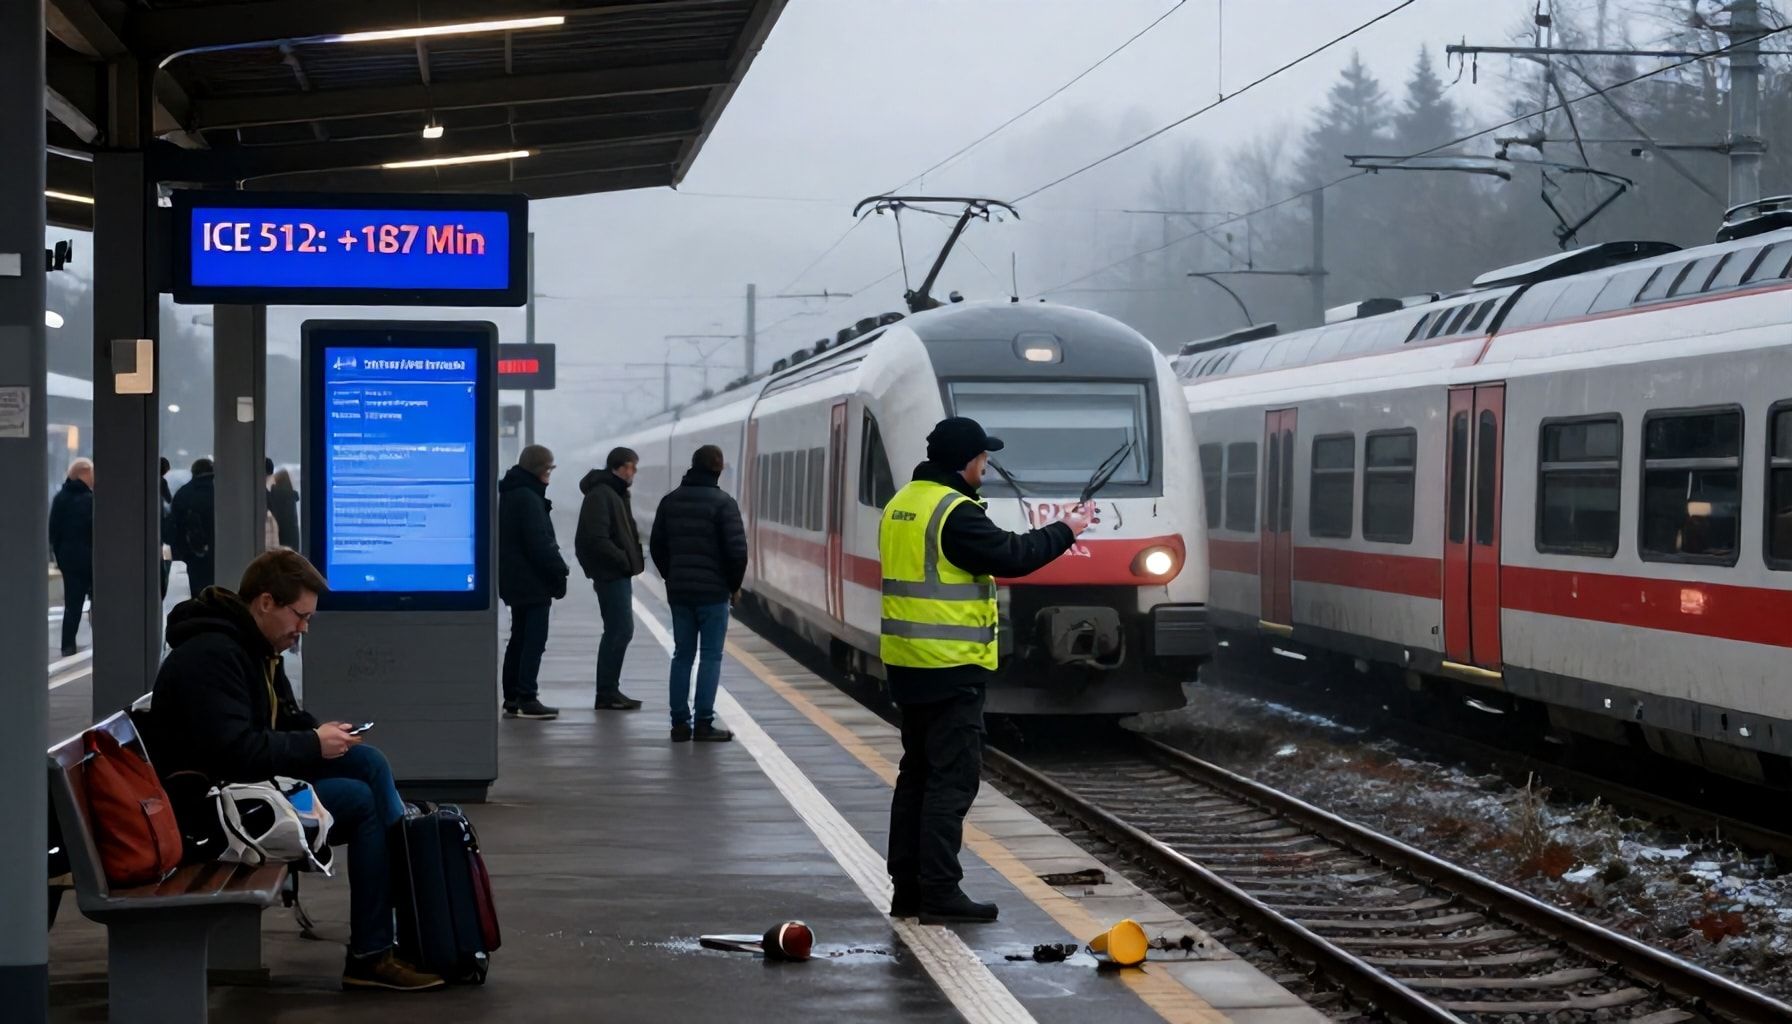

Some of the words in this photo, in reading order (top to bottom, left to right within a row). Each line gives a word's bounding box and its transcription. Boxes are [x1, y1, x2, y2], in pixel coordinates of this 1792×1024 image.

[203, 222, 252, 252] ICE
[259, 222, 327, 253] 512:
[426, 224, 485, 255] Min
